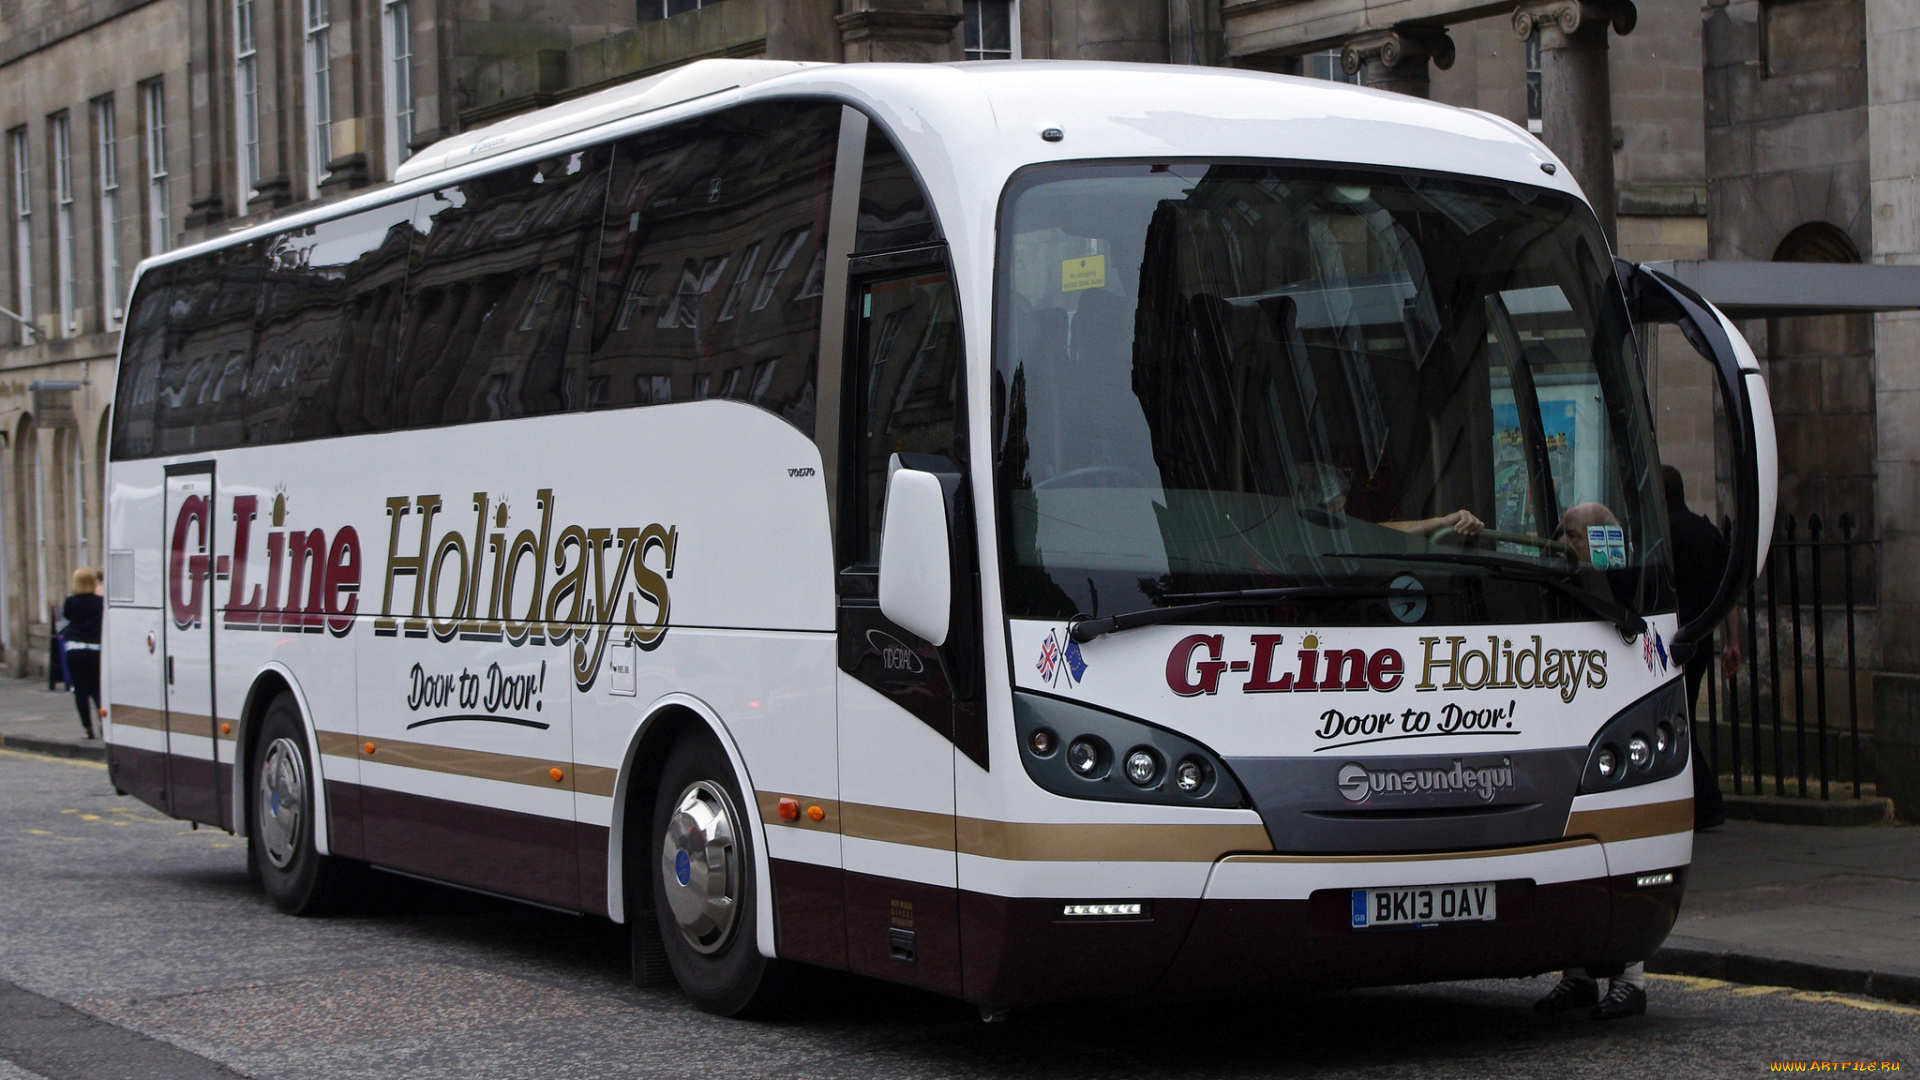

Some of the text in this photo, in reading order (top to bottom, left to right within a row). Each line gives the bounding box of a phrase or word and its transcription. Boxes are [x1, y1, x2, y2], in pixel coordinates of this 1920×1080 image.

[787, 467, 815, 478] VOLVO
[169, 488, 678, 693] G-Line Holidays
[407, 660, 547, 713] Door to Door!
[1165, 633, 1608, 704] G-Line Holidays
[1315, 700, 1516, 739] Door to Door!
[1338, 756, 1515, 804] Sunsundegui
[1375, 887, 1488, 922] BK13 OAV
